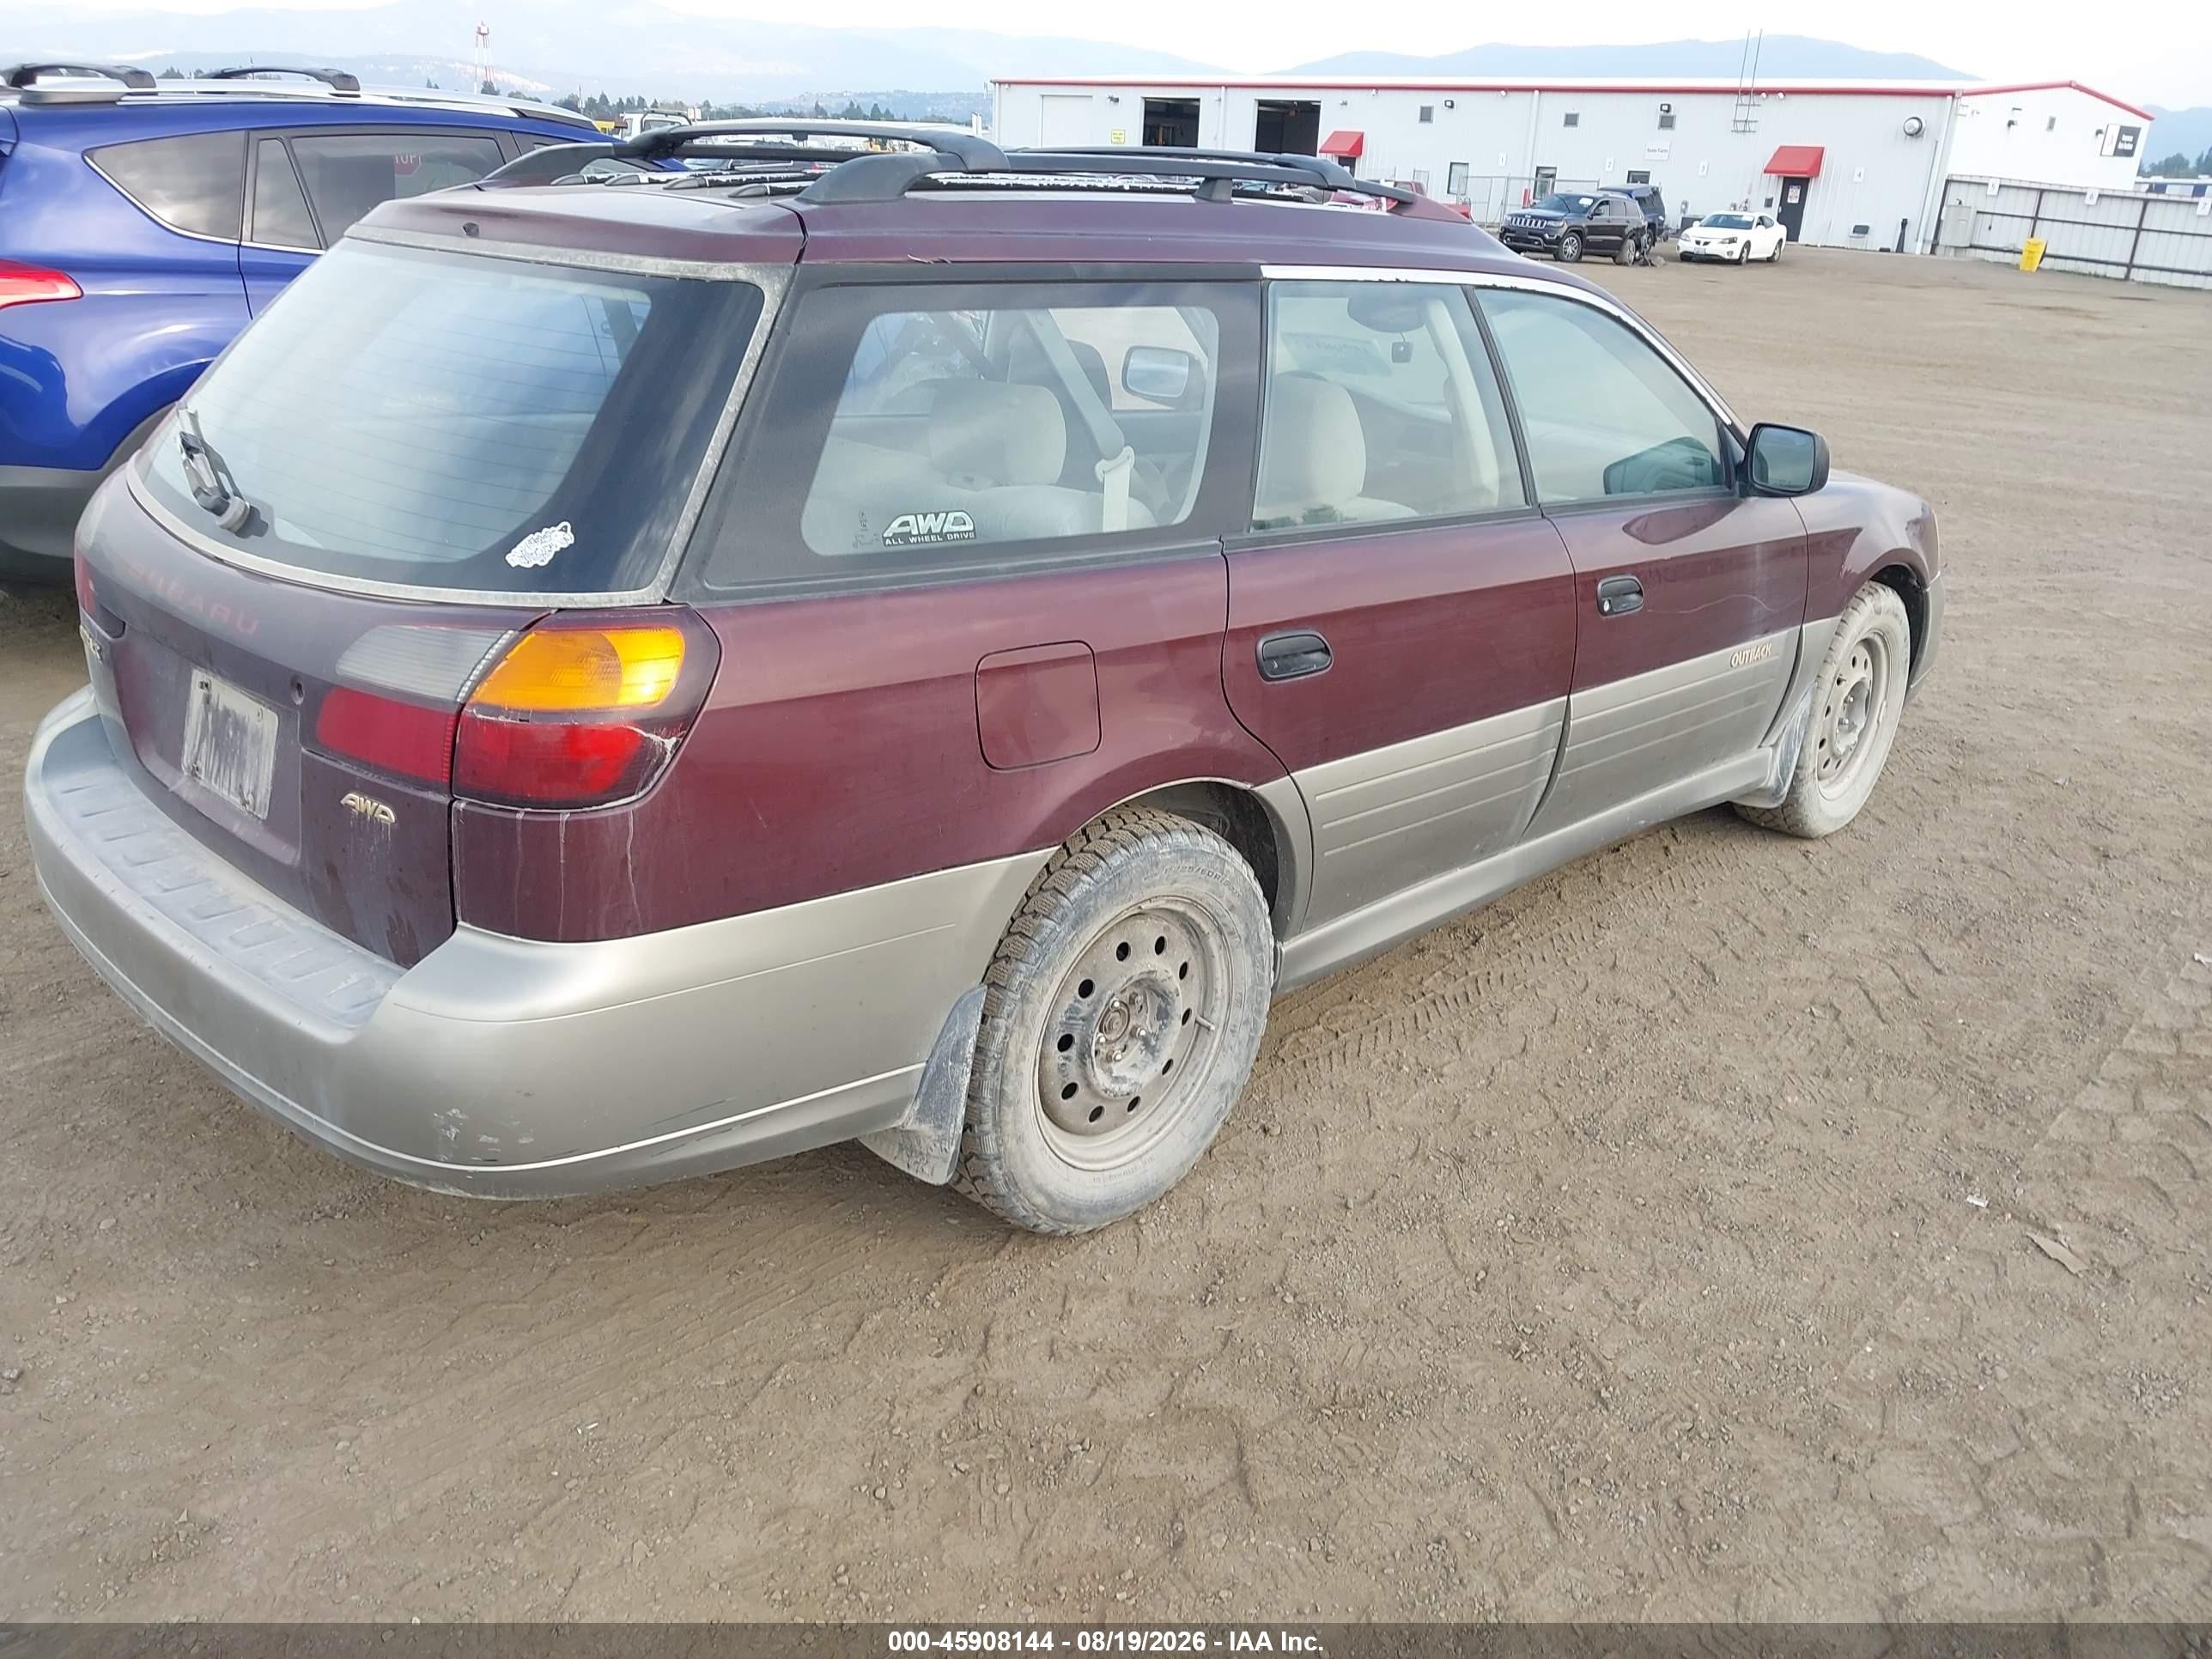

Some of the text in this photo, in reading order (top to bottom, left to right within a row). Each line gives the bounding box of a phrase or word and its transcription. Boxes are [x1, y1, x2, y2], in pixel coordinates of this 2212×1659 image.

[883, 511, 975, 538] AWD
[885, 531, 975, 546] ALL WHEEL DRIVE
[1730, 643, 1773, 668] OUTBACK
[340, 793, 397, 825] AWD
